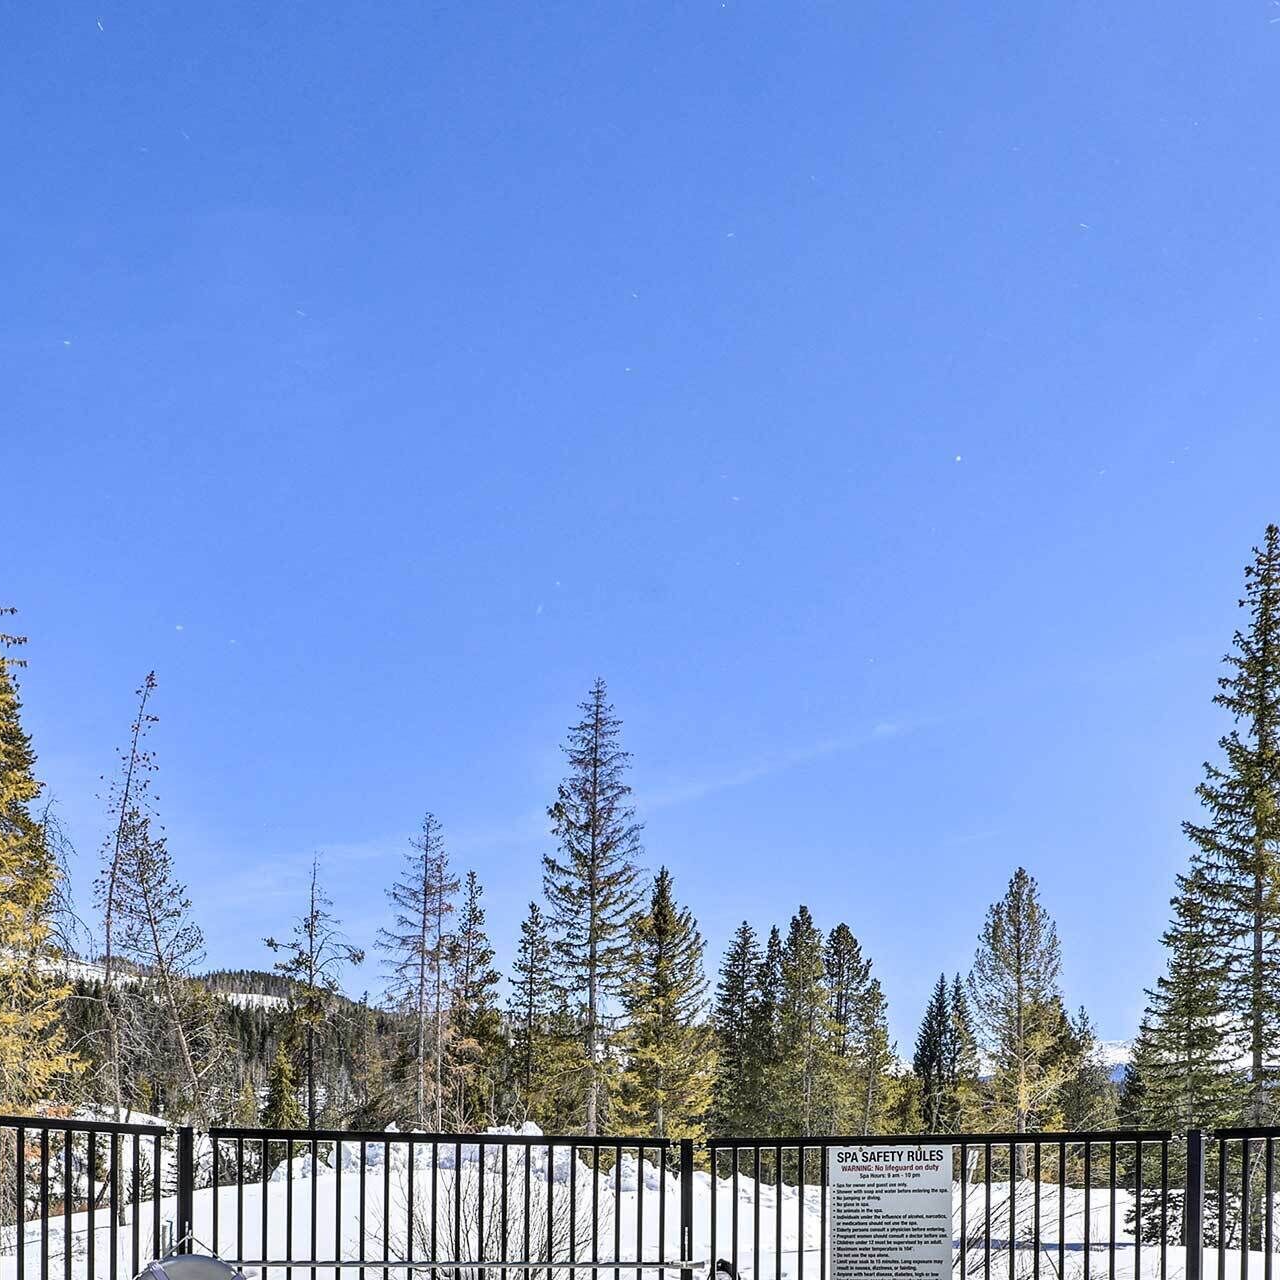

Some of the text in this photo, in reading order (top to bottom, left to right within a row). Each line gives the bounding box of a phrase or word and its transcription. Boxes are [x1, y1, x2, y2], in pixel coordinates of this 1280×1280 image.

[837, 1150, 944, 1163] SPA SAFETY RULES
[885, 1164, 914, 1172] lifeguard
